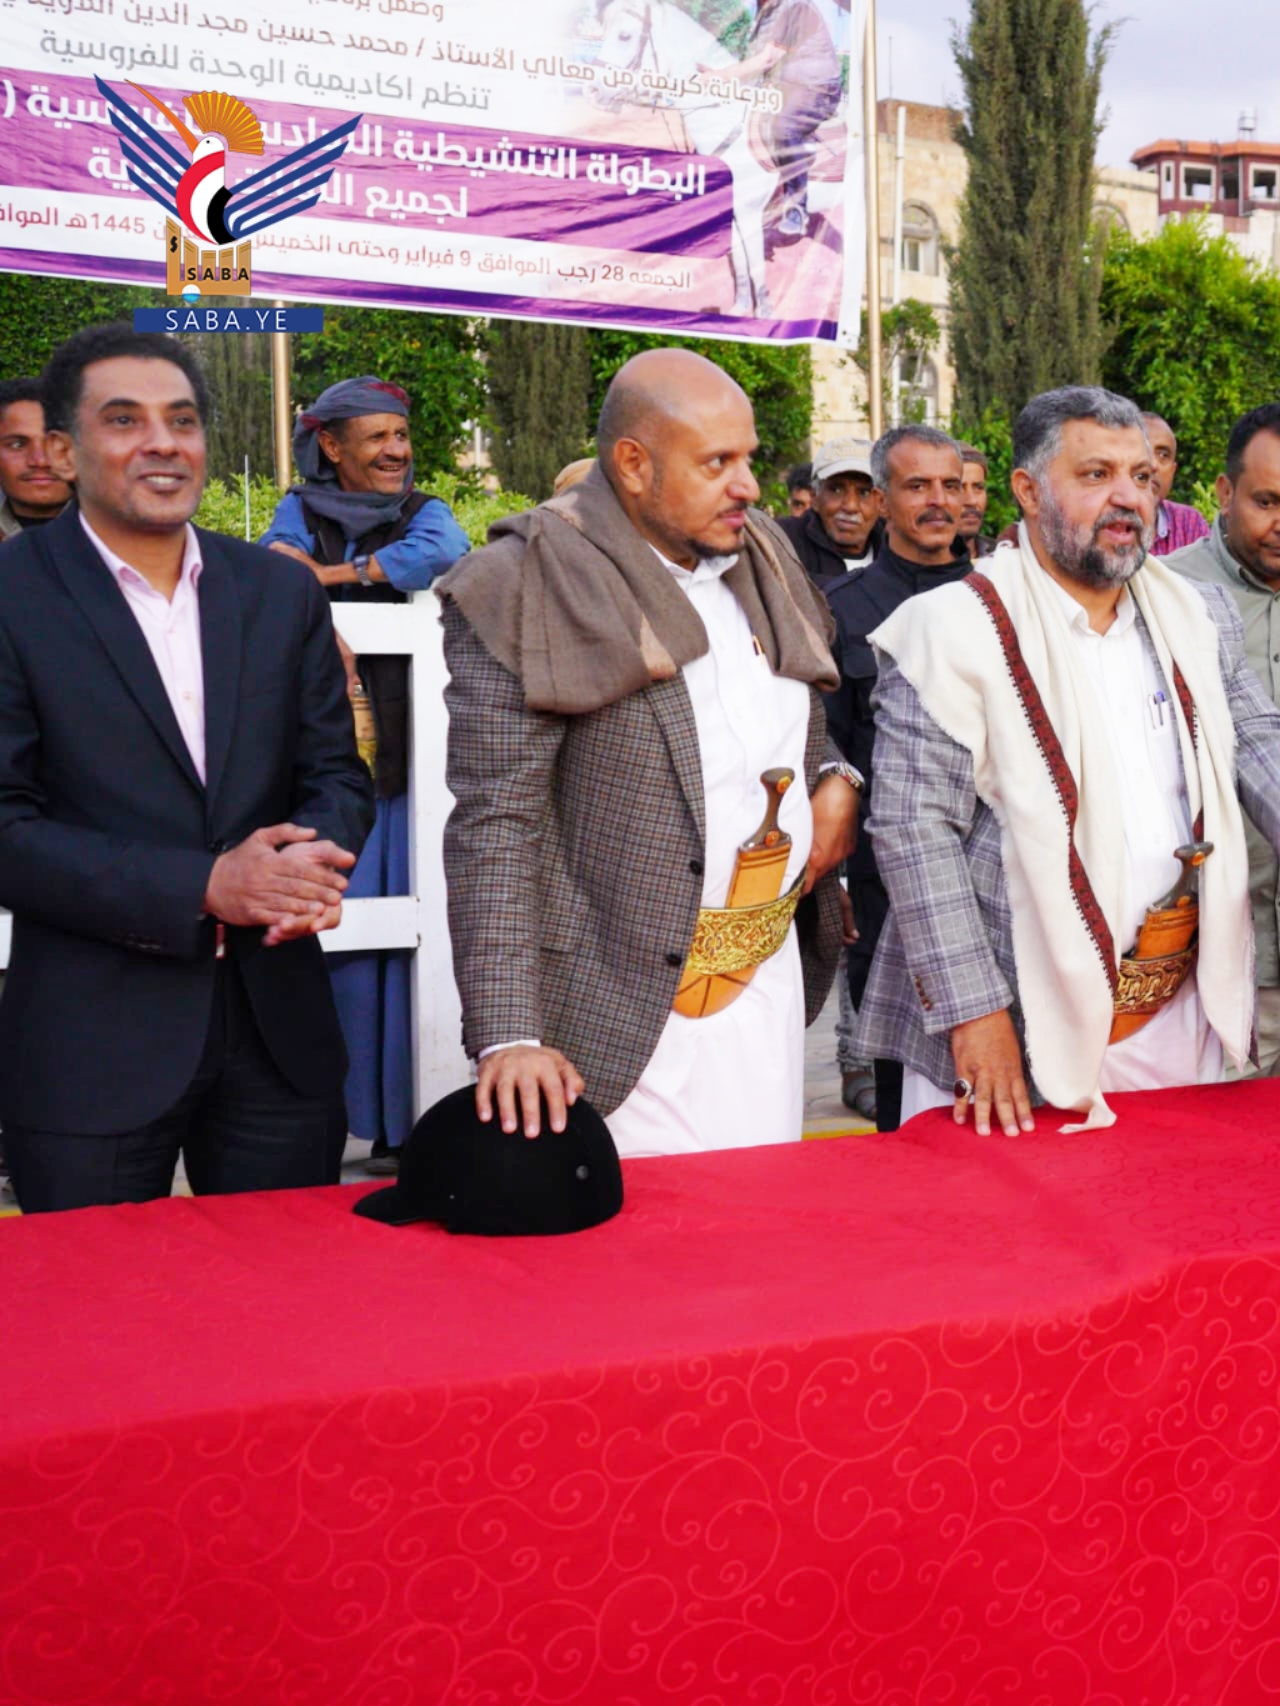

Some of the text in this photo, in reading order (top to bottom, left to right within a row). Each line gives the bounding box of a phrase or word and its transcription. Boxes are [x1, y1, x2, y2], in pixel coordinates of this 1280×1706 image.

[124, 0, 189, 27] الدين
[197, 12, 249, 37] مجد
[257, 18, 336, 46] حسين
[343, 33, 409, 56] محمد
[40, 28, 179, 71] للفروسية
[189, 48, 285, 87] الوحدة
[523, 54, 596, 81] معالي
[603, 65, 634, 89] من
[422, 81, 492, 110] تنظم
[641, 67, 703, 98] كريمة
[708, 77, 783, 112] وبرعاية
[393, 129, 578, 181] التنشيطية
[586, 152, 706, 201] البطولة
[365, 185, 469, 225] لجميع
[252, 233, 331, 254] الخميس
[338, 239, 399, 264] وحتى
[405, 245, 455, 269] فبراير
[459, 250, 471, 267] 9
[478, 251, 551, 276] الموافق
[557, 264, 596, 283] رجب
[602, 264, 625, 282] 28
